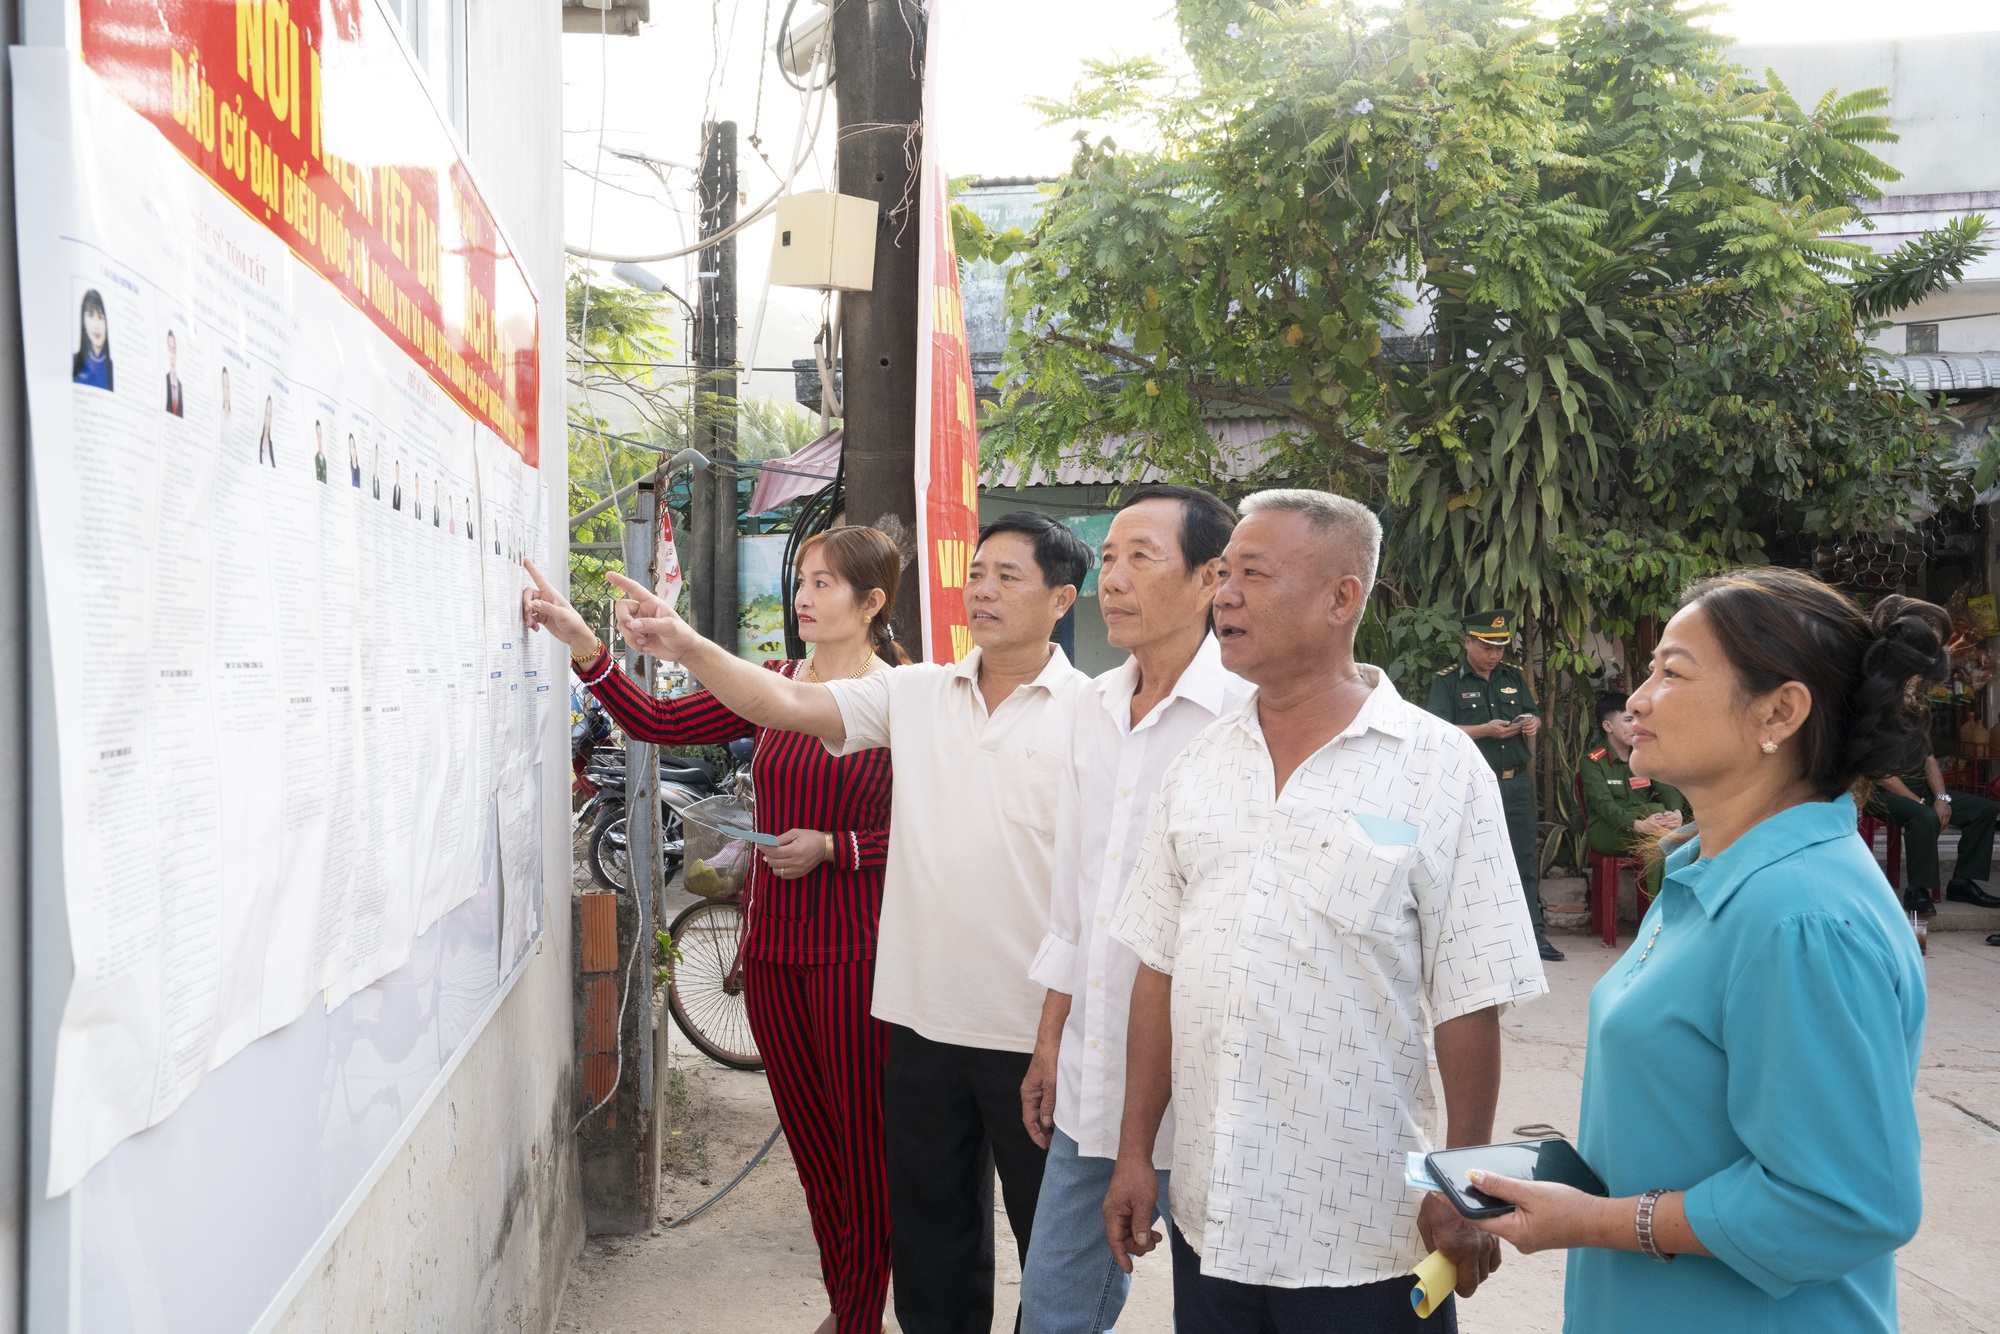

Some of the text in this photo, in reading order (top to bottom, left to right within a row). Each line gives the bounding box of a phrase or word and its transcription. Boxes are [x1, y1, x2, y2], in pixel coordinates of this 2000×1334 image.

[236, 0, 300, 140] NƠI
[171, 45, 215, 153] BẦU
[220, 94, 247, 182] CỬ
[250, 129, 279, 221] ĐẠI
[283, 160, 317, 247] BIỂU
[321, 204, 351, 280] QUỐC
[372, 259, 395, 326] KHÓA
[396, 286, 410, 340] XVI
[411, 299, 422, 352] VÀ
[424, 315, 436, 371] ĐẠI
